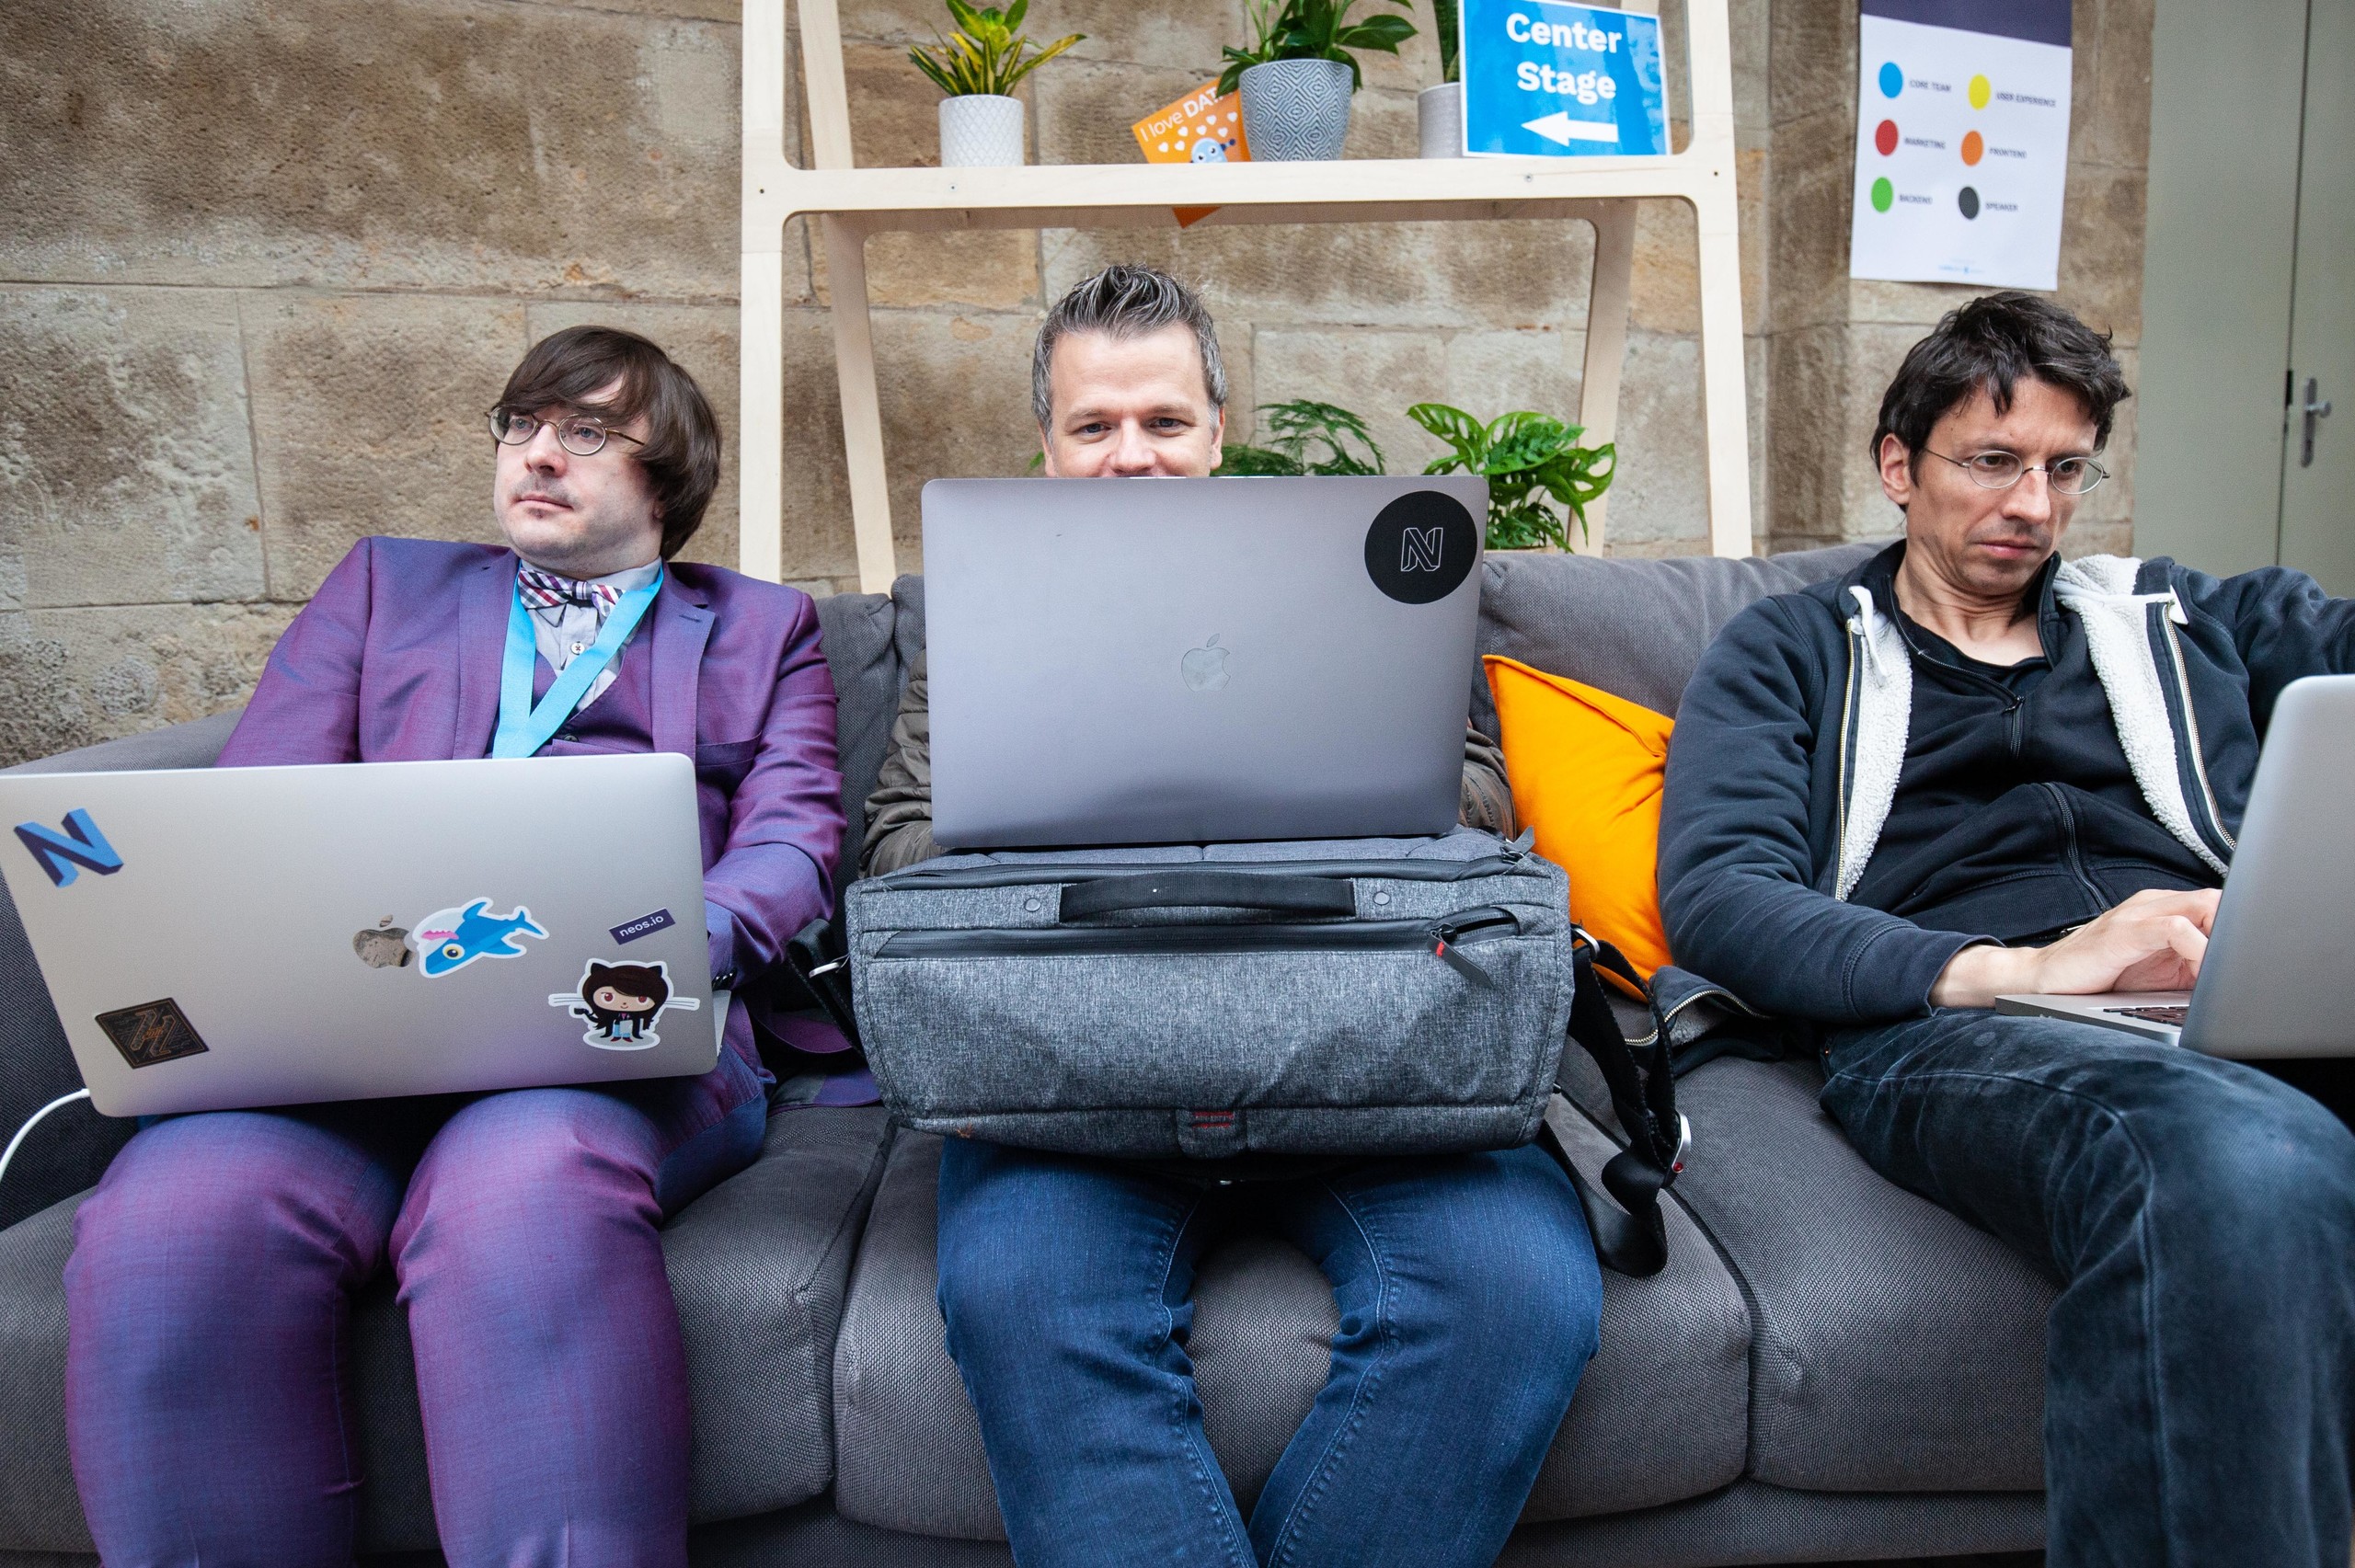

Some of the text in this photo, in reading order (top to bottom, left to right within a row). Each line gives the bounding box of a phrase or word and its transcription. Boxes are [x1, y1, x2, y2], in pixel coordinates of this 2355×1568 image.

[1506, 12, 1622, 53] Center
[1517, 61, 1616, 106] Stage
[1139, 86, 1233, 142] I love DAT
[1904, 137, 1947, 150] MARKETING
[1985, 201, 2018, 212] SPEAKER
[1400, 527, 1443, 572] N
[13, 807, 124, 888] N
[619, 916, 664, 937] neos.io
